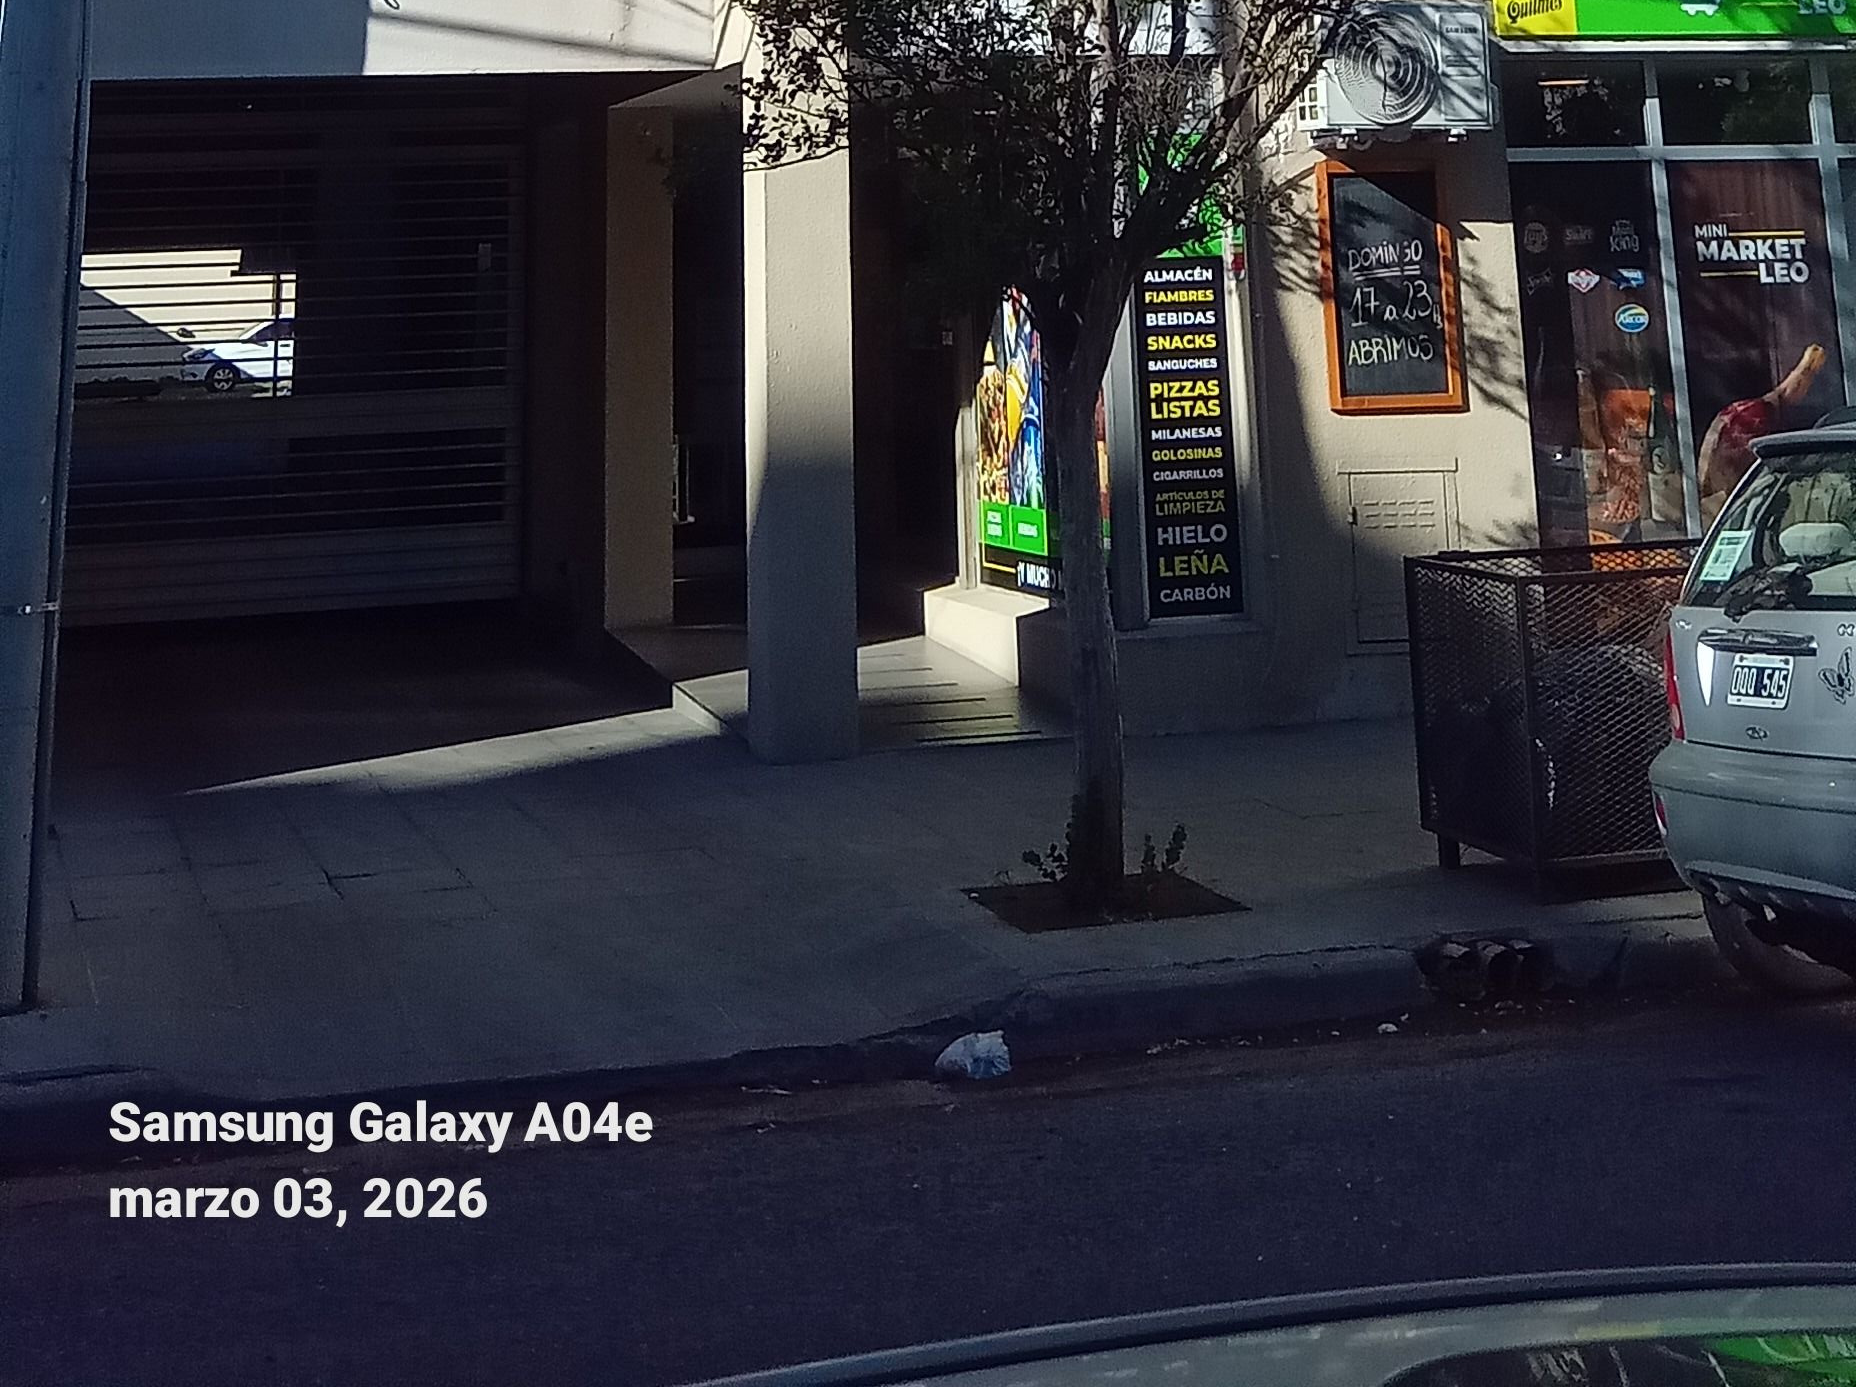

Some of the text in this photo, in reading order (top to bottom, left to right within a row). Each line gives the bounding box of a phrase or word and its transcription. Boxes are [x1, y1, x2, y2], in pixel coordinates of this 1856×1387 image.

[1694, 223, 1728, 239] MINI
[1696, 238, 1806, 262] MARKET
[1144, 266, 1213, 283] ALMACÉN
[1758, 261, 1809, 283] LEO
[1145, 289, 1214, 303] FIAMBRES
[1350, 287, 1380, 327] 17
[1402, 280, 1433, 320] 23
[1146, 311, 1215, 327] BEBIDAS
[1147, 334, 1217, 350] SNACKS
[1348, 334, 1433, 366] ABRIMOS
[1148, 358, 1217, 371] SANGUCHES
[1150, 380, 1220, 399] PIZZAS
[1151, 400, 1221, 419] LISTAS
[1151, 427, 1222, 441] MILANESAS
[1152, 447, 1222, 461] GOLOSINAS
[1153, 468, 1224, 482] CIGARRILLOS
[1211, 489, 1225, 499] DE
[1155, 500, 1226, 516] LIMPIEZA
[1157, 524, 1228, 546] HIELO
[1159, 549, 1230, 577] LEÑA
[1160, 583, 1231, 603] CARBÓN
[1761, 669, 1788, 698] 545
